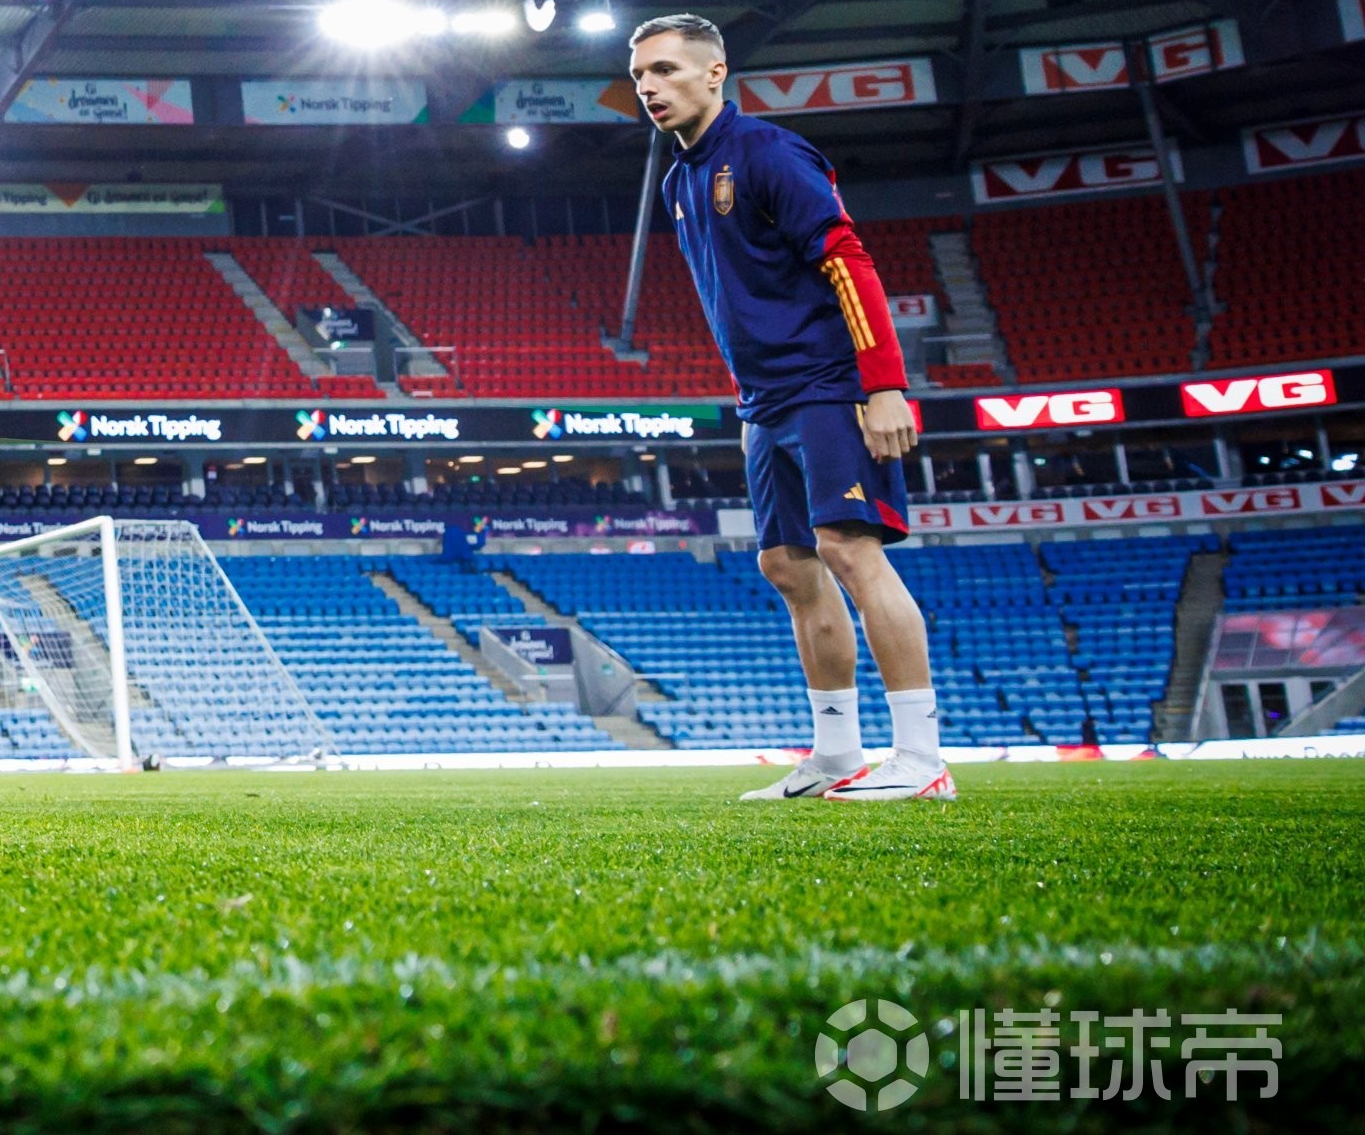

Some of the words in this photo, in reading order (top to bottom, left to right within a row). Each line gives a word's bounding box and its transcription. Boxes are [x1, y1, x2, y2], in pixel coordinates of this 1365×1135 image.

[741, 68, 904, 109] VG
[300, 98, 339, 110] Norsk
[342, 98, 391, 113] Tipping
[990, 150, 1161, 193] VG
[1184, 372, 1328, 414] VG
[977, 393, 1119, 428] VG
[91, 417, 148, 438] Norsk
[149, 415, 221, 440] Tipping
[329, 415, 386, 436] Norsk
[387, 413, 459, 439] Tipping
[565, 416, 621, 436] Norsk
[622, 413, 693, 438] Tipping
[974, 503, 1062, 524] VG
[1085, 496, 1180, 521] VG
[1203, 489, 1300, 515] VG
[0, 522, 32, 535] Norsk
[248, 521, 280, 533] Norsk
[282, 520, 322, 535] Tipping
[370, 520, 402, 532] Norsk
[405, 519, 444, 534] Tipping
[493, 519, 525, 530] Norsk
[527, 517, 567, 533] Tipping
[615, 518, 647, 529] Norsk
[649, 517, 689, 532] Tipping
